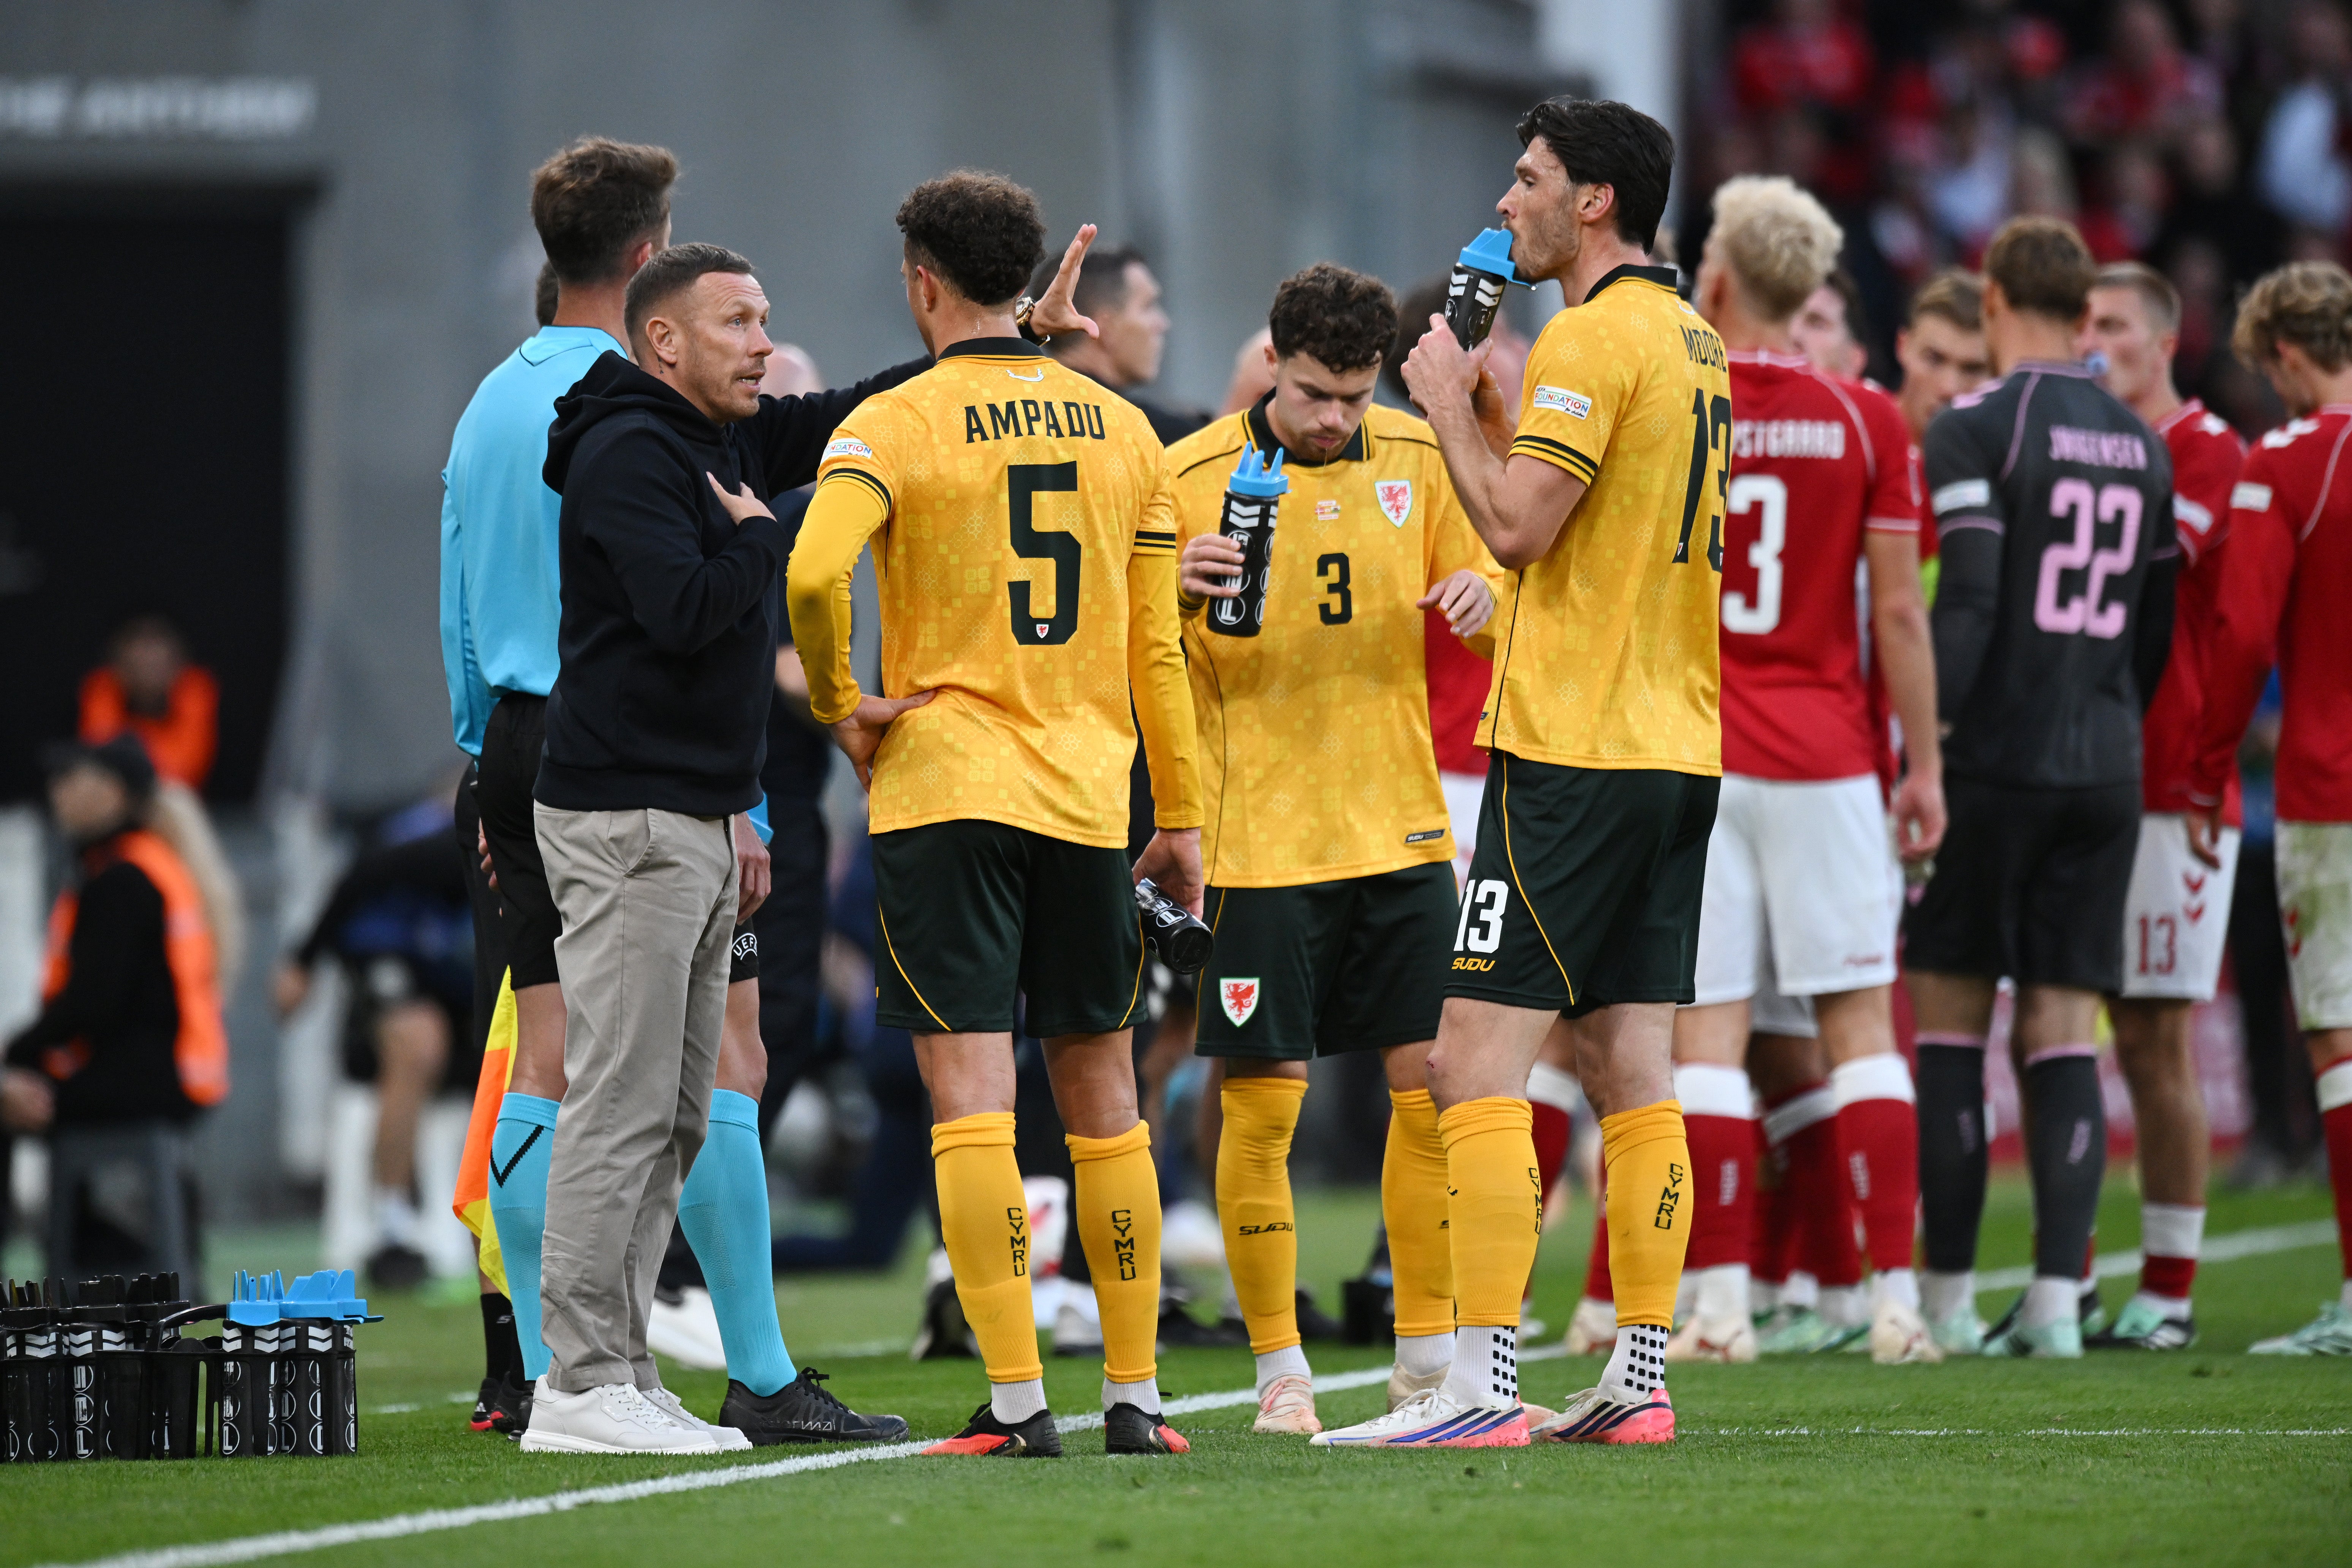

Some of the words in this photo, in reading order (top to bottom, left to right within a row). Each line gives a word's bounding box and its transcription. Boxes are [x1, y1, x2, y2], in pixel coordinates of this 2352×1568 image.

[1680, 325, 1727, 373] MOORE
[964, 400, 1106, 444] AMPADU
[1535, 392, 1589, 413] FOUNDATION
[828, 444, 872, 454] NDATION
[1672, 387, 1731, 574] 13
[1007, 460, 1082, 646] 5
[1721, 474, 1788, 634] 3
[2033, 476, 2143, 640] 22
[1316, 552, 1352, 626] 3
[1453, 879, 1509, 954] 13
[2137, 915, 2177, 975] 13
[1451, 957, 1495, 972] SUDU
[1239, 1222, 1293, 1236] SUDU
[1528, 1167, 1542, 1235] CYMRU
[1654, 1163, 1683, 1230] CYMRU
[1007, 1208, 1026, 1277] CYMRU
[1112, 1209, 1136, 1281] CYMRU
